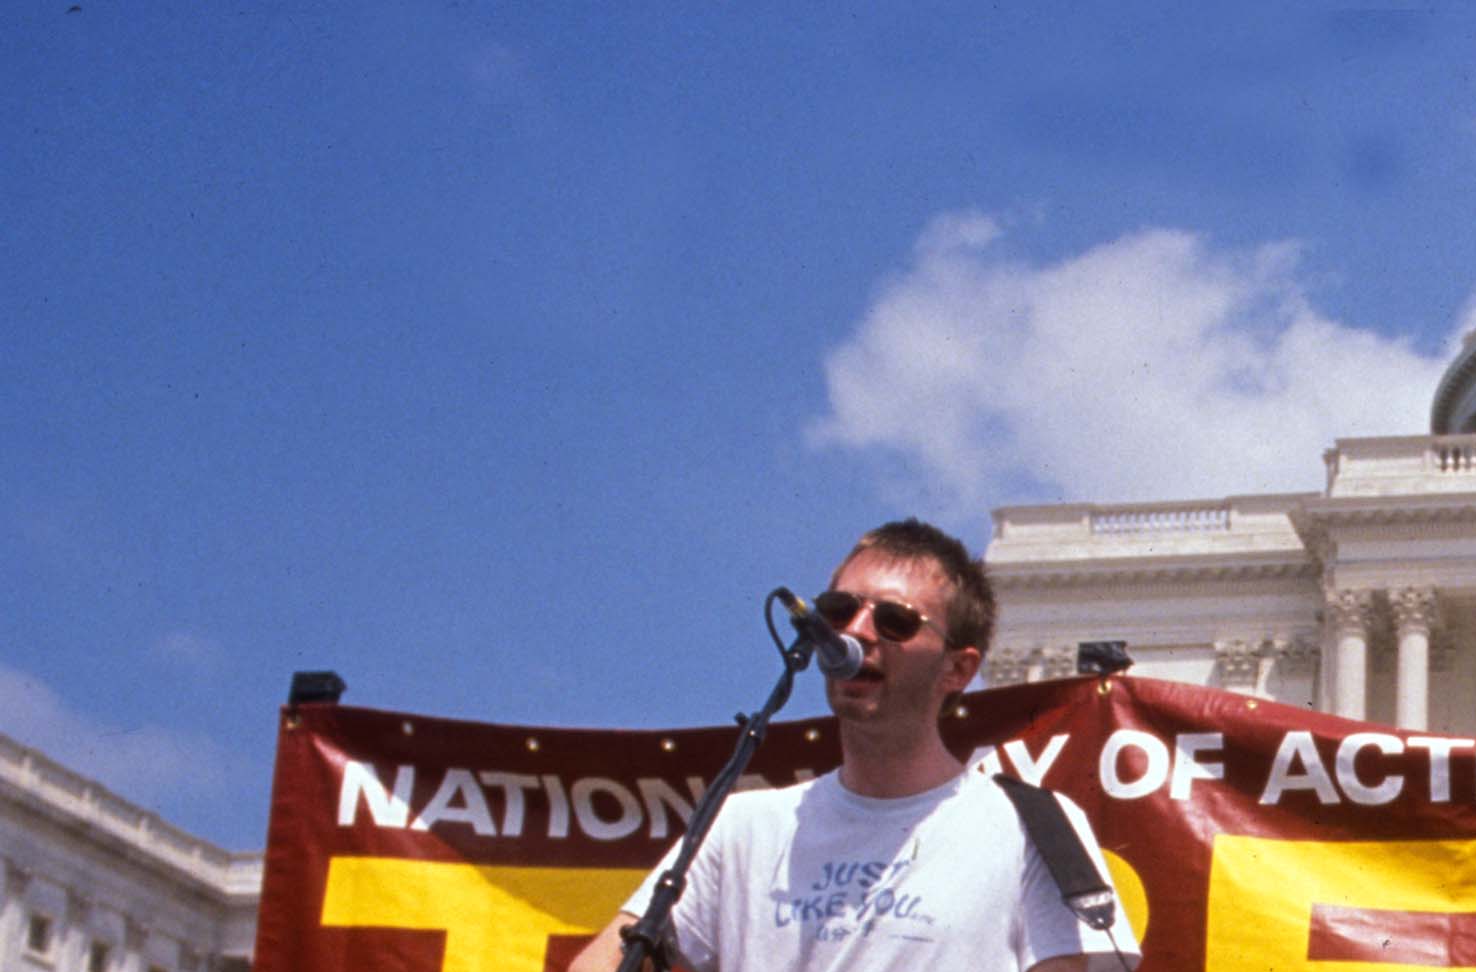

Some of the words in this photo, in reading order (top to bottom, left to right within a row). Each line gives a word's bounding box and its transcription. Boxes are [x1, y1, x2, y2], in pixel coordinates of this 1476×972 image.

[337, 760, 816, 841] NATION
[1099, 729, 1225, 802] OF
[811, 860, 910, 892] JUST
[769, 889, 849, 928] LIKE
